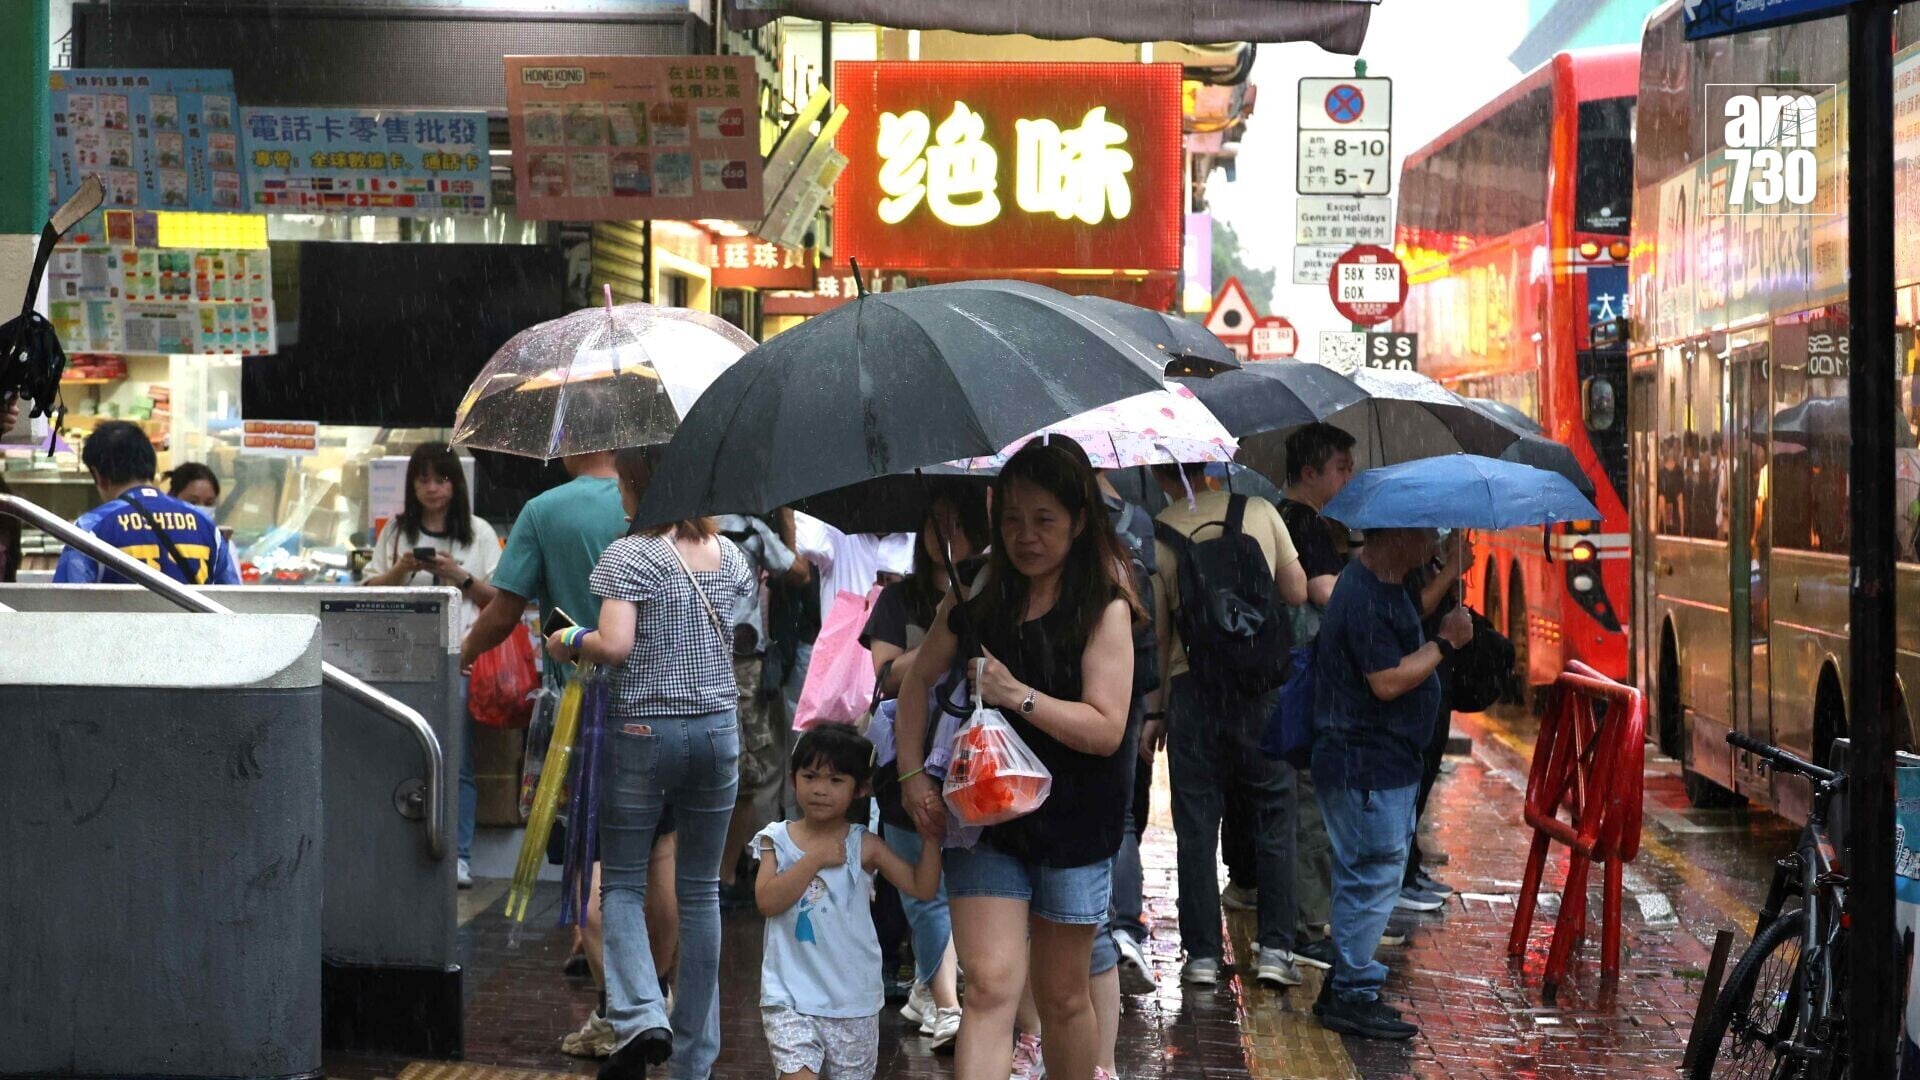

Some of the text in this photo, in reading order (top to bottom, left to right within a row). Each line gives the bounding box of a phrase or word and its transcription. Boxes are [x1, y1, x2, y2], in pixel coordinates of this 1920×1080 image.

[525, 69, 553, 82] HONG
[555, 69, 583, 82] KONG
[249, 115, 478, 144] 電話卡零售批發
[1309, 136, 1325, 144] am
[1304, 146, 1329, 158] 上午
[1334, 139, 1384, 157] 8-10
[1309, 165, 1325, 174] pm
[1304, 175, 1329, 187] 下午
[1326, 202, 1361, 212] Except
[1301, 212, 1386, 223] General Holidays
[1344, 267, 1365, 281] 58X
[1375, 267, 1395, 281] 59X
[1344, 286, 1365, 300] 60X
